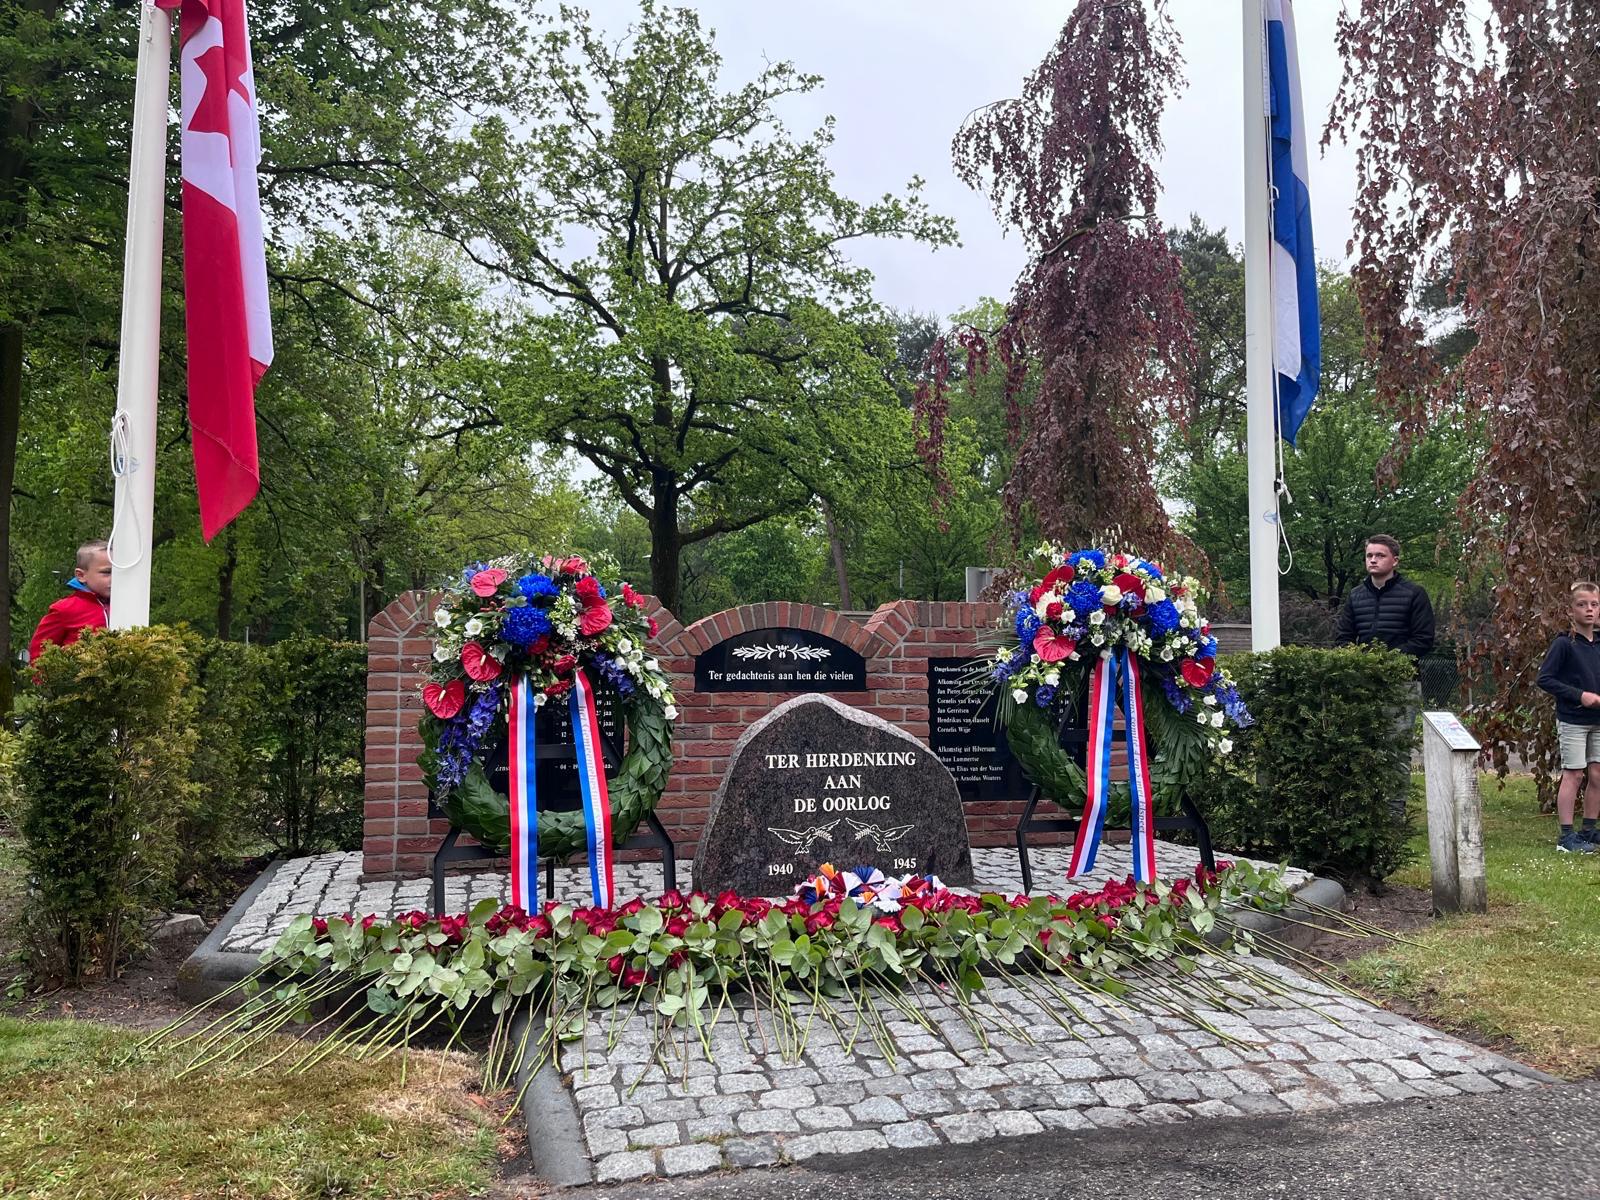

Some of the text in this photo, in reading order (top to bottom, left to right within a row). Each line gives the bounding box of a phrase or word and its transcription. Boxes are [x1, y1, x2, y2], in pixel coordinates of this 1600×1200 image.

[708, 670, 854, 682] Ter gedachtenis aan hen die vielen
[938, 745, 962, 753] Afkomstig
[766, 751, 917, 770] TER HERDENKING
[823, 774, 862, 790] AAN
[794, 795, 892, 813] DE OORLOG
[1138, 801, 1147, 834] Elspeet
[596, 838, 607, 888] Nunspeet
[768, 858, 917, 876] 1940 1945
